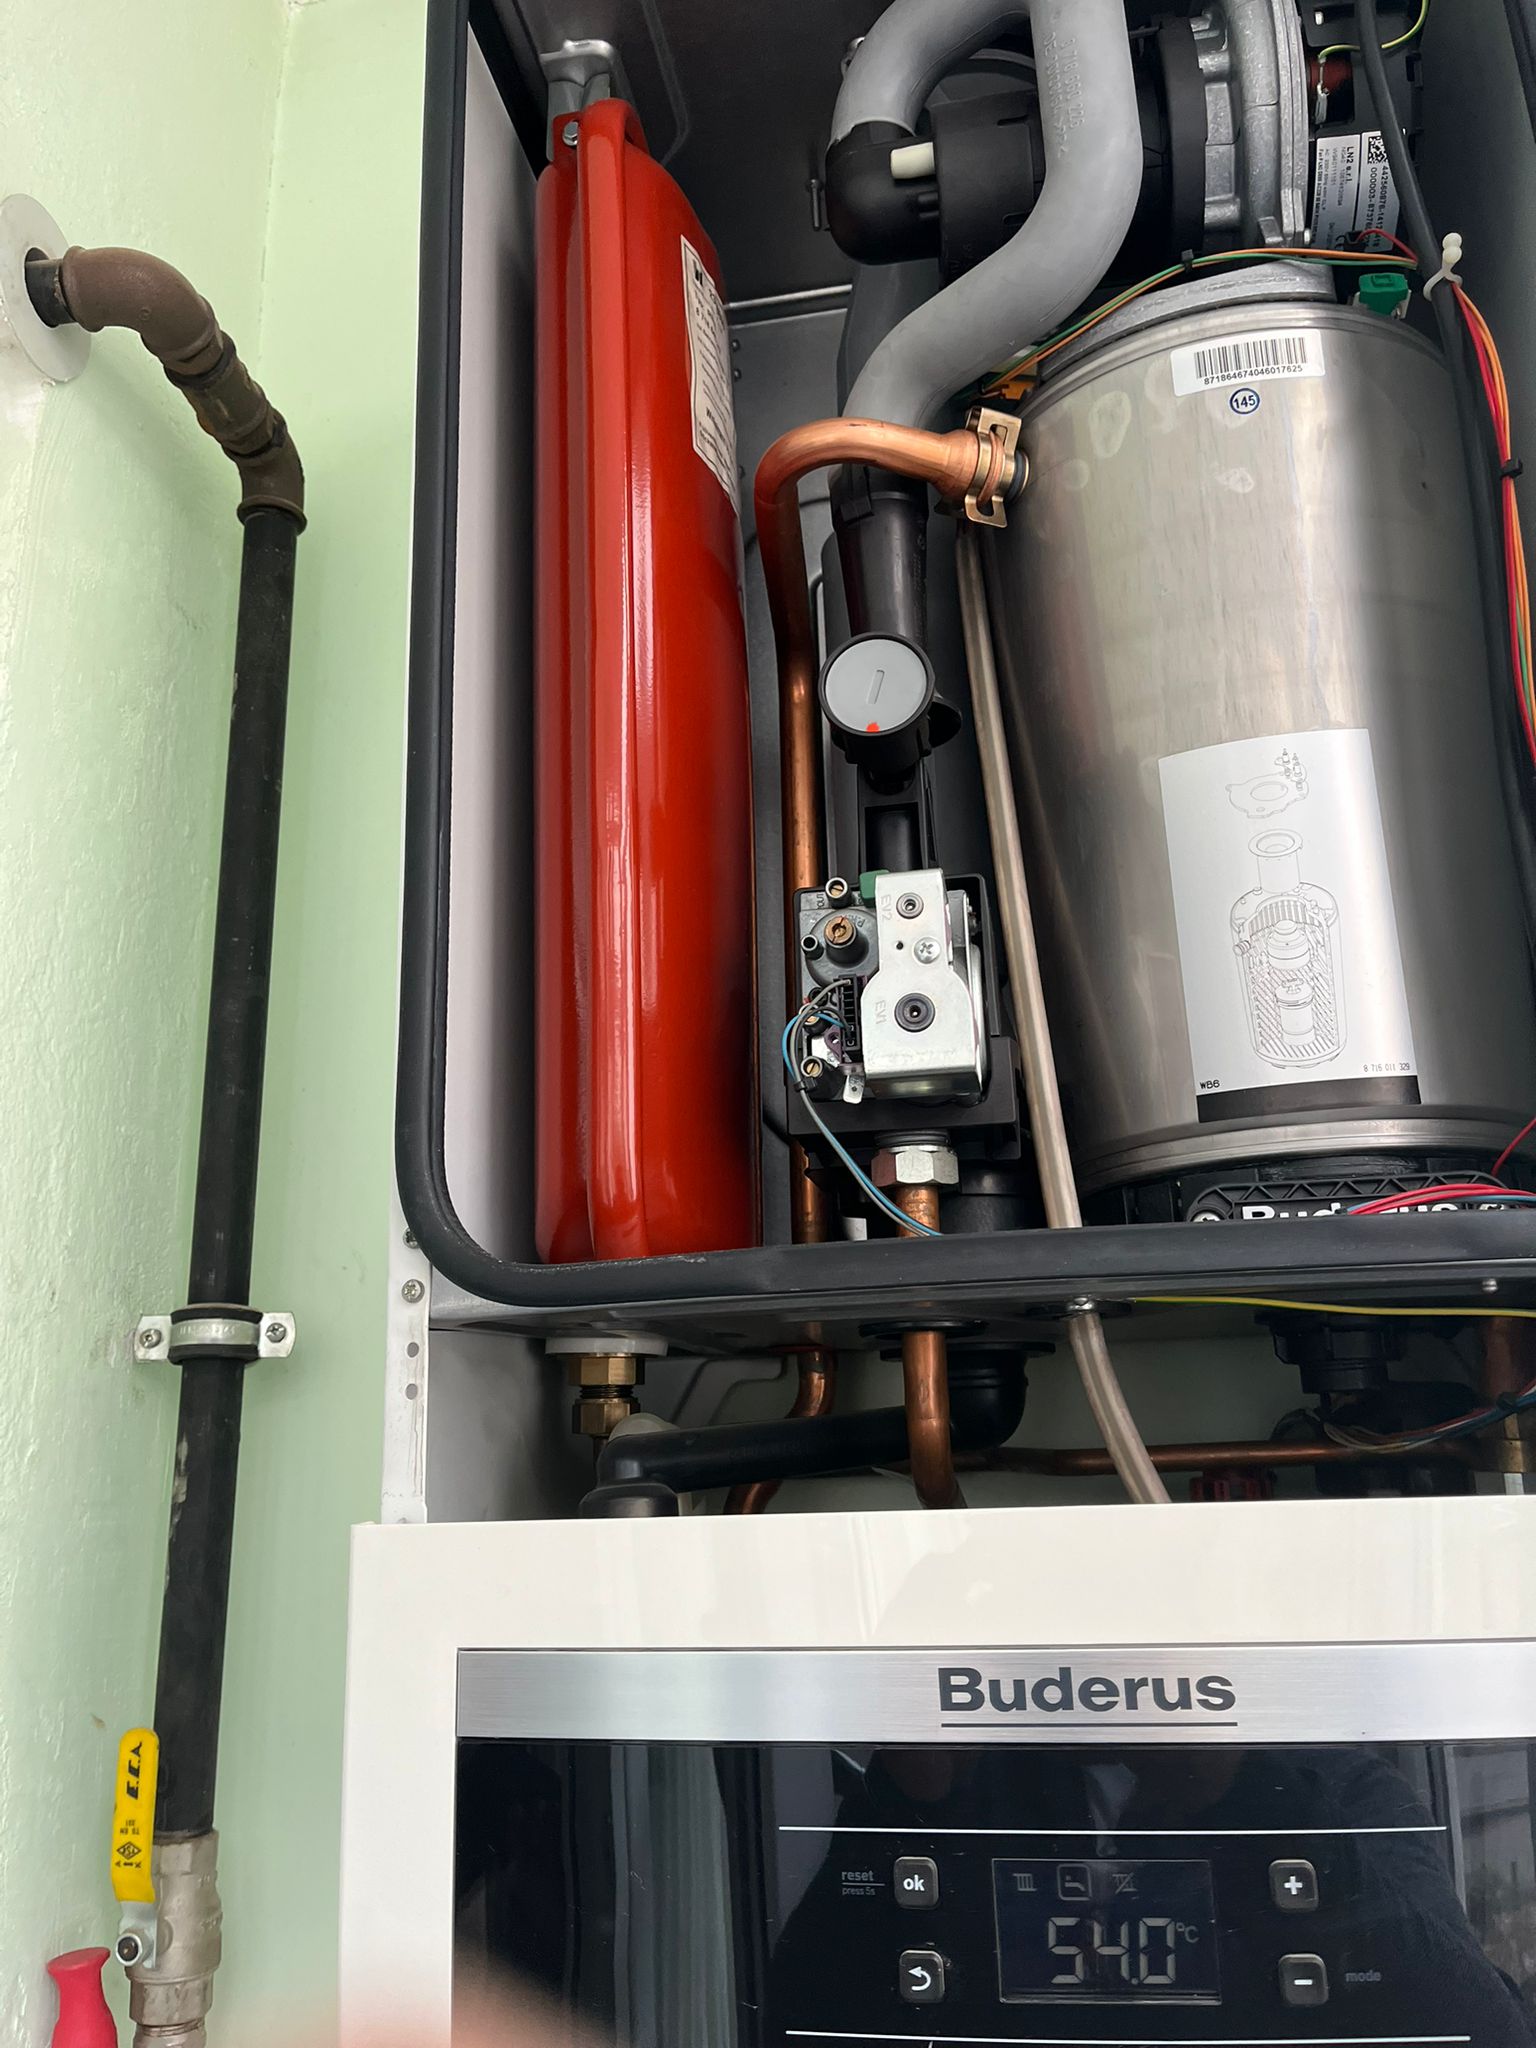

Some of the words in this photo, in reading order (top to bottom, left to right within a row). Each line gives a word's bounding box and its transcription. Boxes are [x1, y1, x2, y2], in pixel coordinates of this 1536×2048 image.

[1233, 395, 1256, 409] 145
[881, 894, 893, 921] EV2
[938, 1667, 1236, 1712] Buderus
[841, 1870, 874, 1881] reset
[903, 1874, 925, 1891] ok
[842, 1887, 864, 1896] press
[1048, 1916, 1176, 1984] 54.0
[1345, 1970, 1381, 1982] mode
